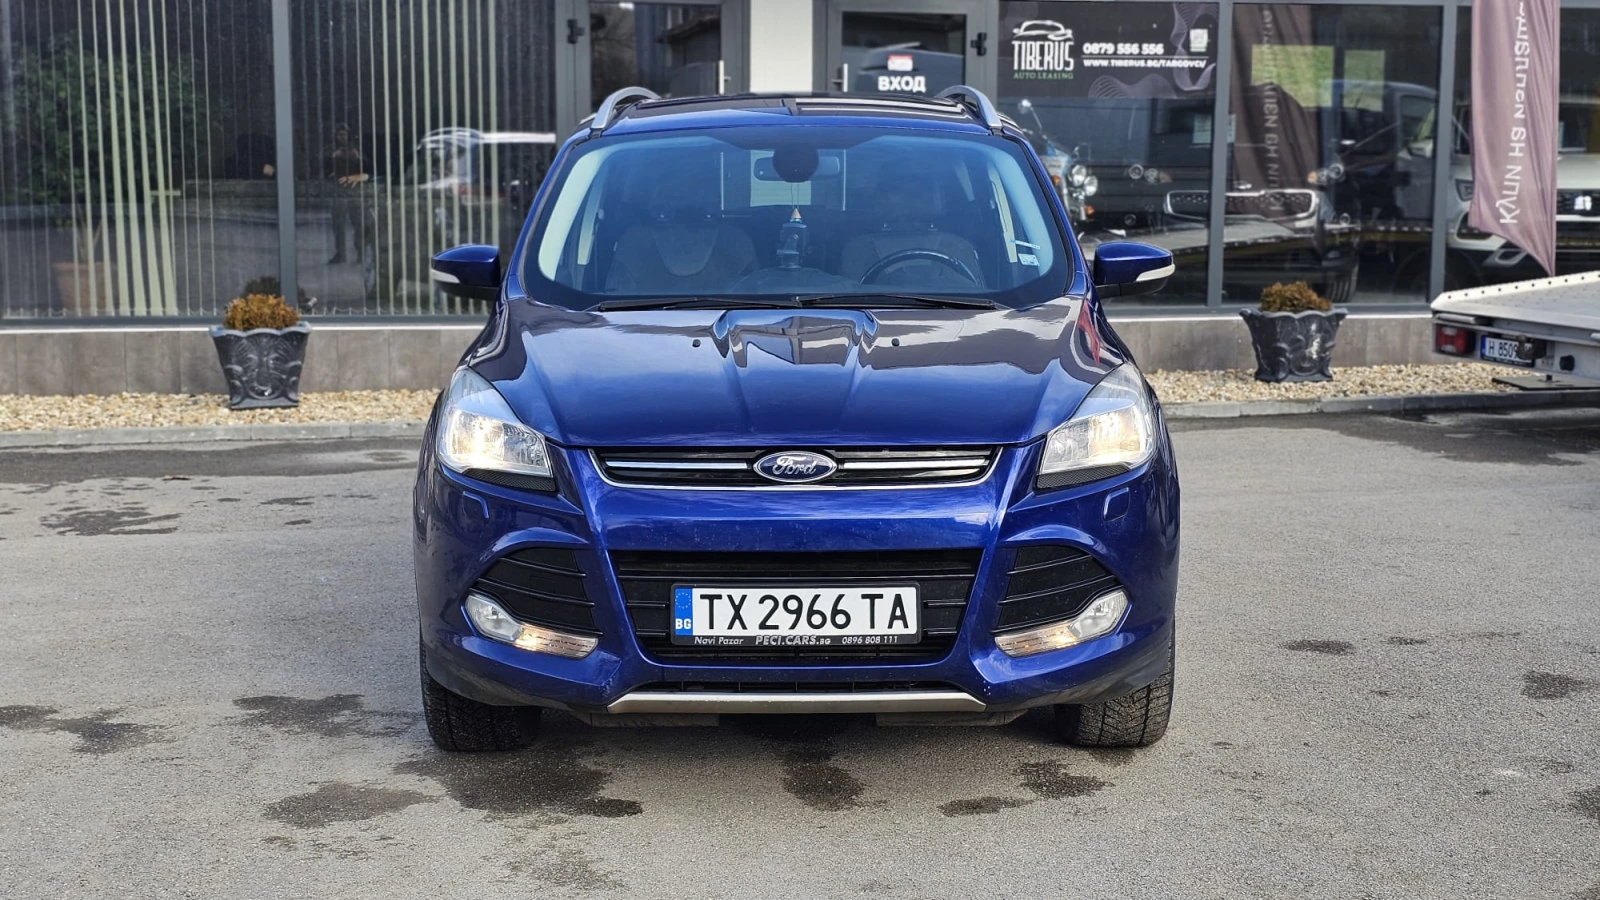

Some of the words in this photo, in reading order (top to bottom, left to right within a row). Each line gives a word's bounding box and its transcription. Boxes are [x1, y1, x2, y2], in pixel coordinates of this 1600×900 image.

[1083, 42, 1115, 55] 0879
[1116, 43, 1140, 55] 556
[1141, 43, 1164, 55] 556
[1012, 40, 1074, 71] TIBERUS
[1013, 72, 1035, 80] AUTO
[1038, 72, 1074, 80] LEASING
[878, 76, 926, 92] ВХОД
[772, 456, 817, 475] Ford
[700, 594, 748, 630] TX
[758, 594, 851, 630] 2966
[861, 594, 909, 629] TA
[675, 618, 691, 630] BG
[718, 636, 744, 645] Pazar
[841, 636, 863, 645] 0896
[864, 636, 880, 645] 808
[883, 635, 898, 644] 111
